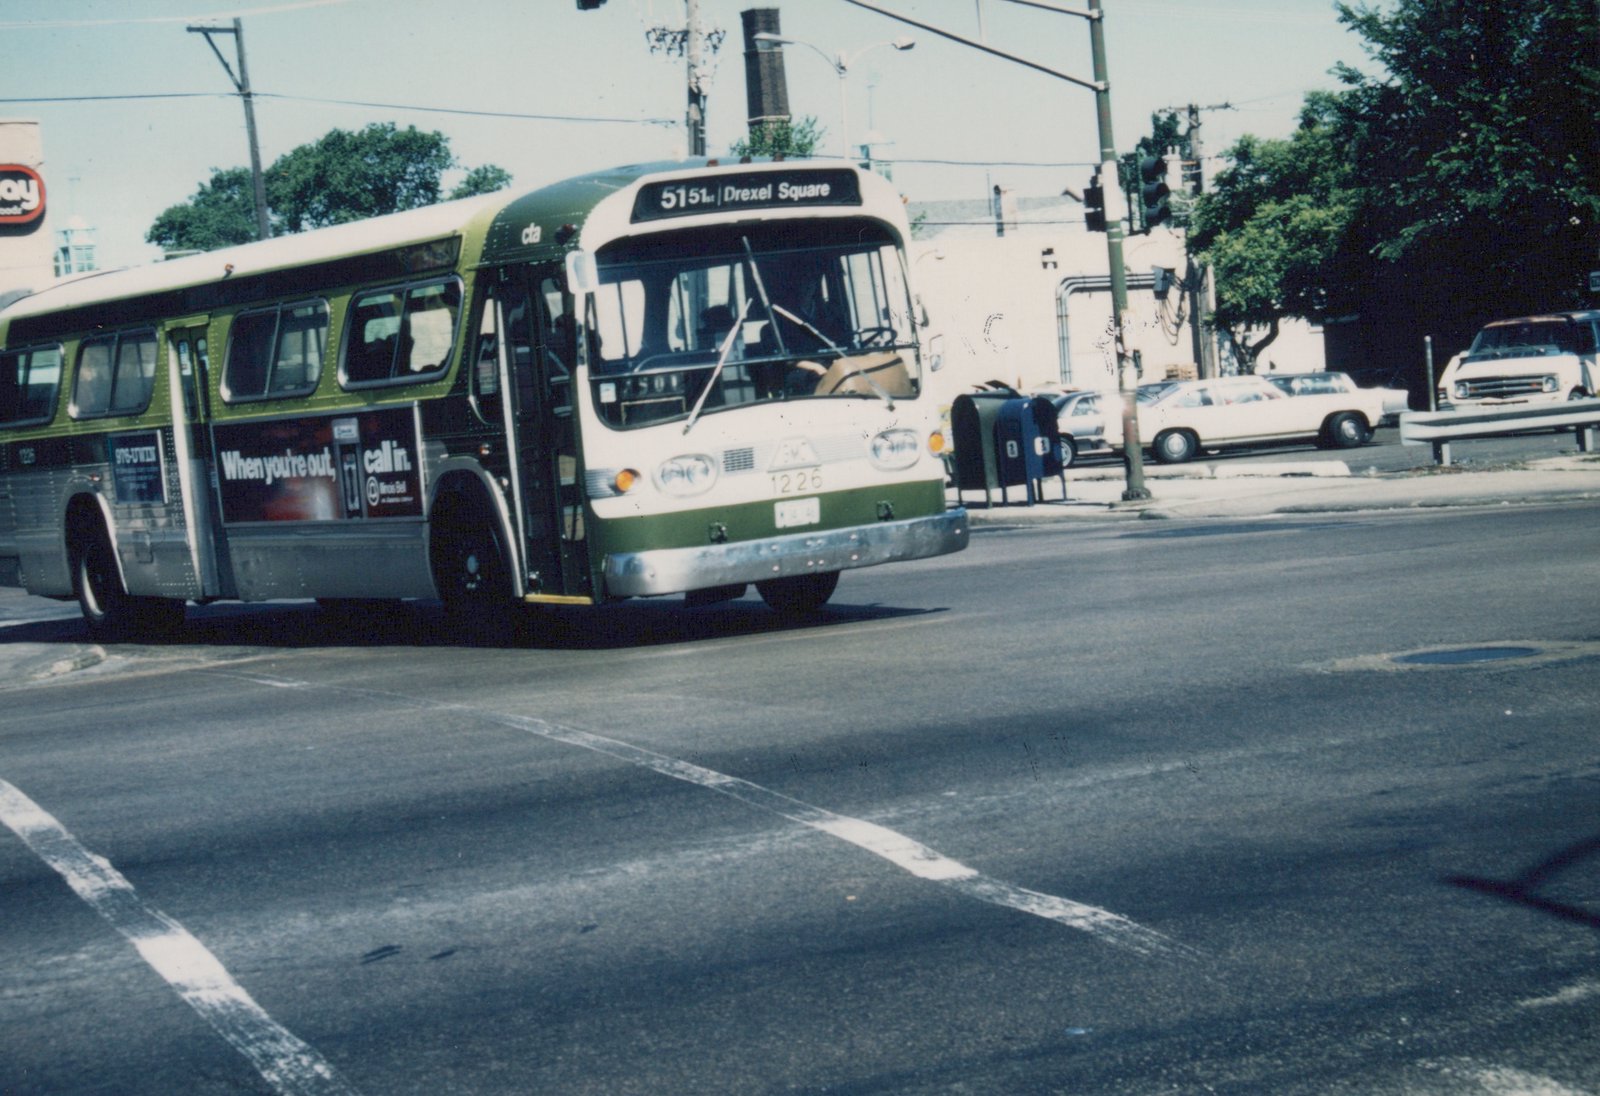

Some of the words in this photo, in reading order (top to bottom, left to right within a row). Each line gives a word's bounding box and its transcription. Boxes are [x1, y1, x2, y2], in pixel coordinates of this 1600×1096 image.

[0, 178, 39, 210] ay
[661, 185, 686, 209] 51
[724, 184, 772, 201] Drexel
[778, 182, 831, 201] Square
[521, 222, 542, 245] cta
[221, 450, 264, 480] When
[264, 448, 308, 485] you're
[307, 447, 336, 482] out,
[363, 440, 393, 474] call
[392, 440, 412, 472] in.
[771, 468, 823, 494] 1226
